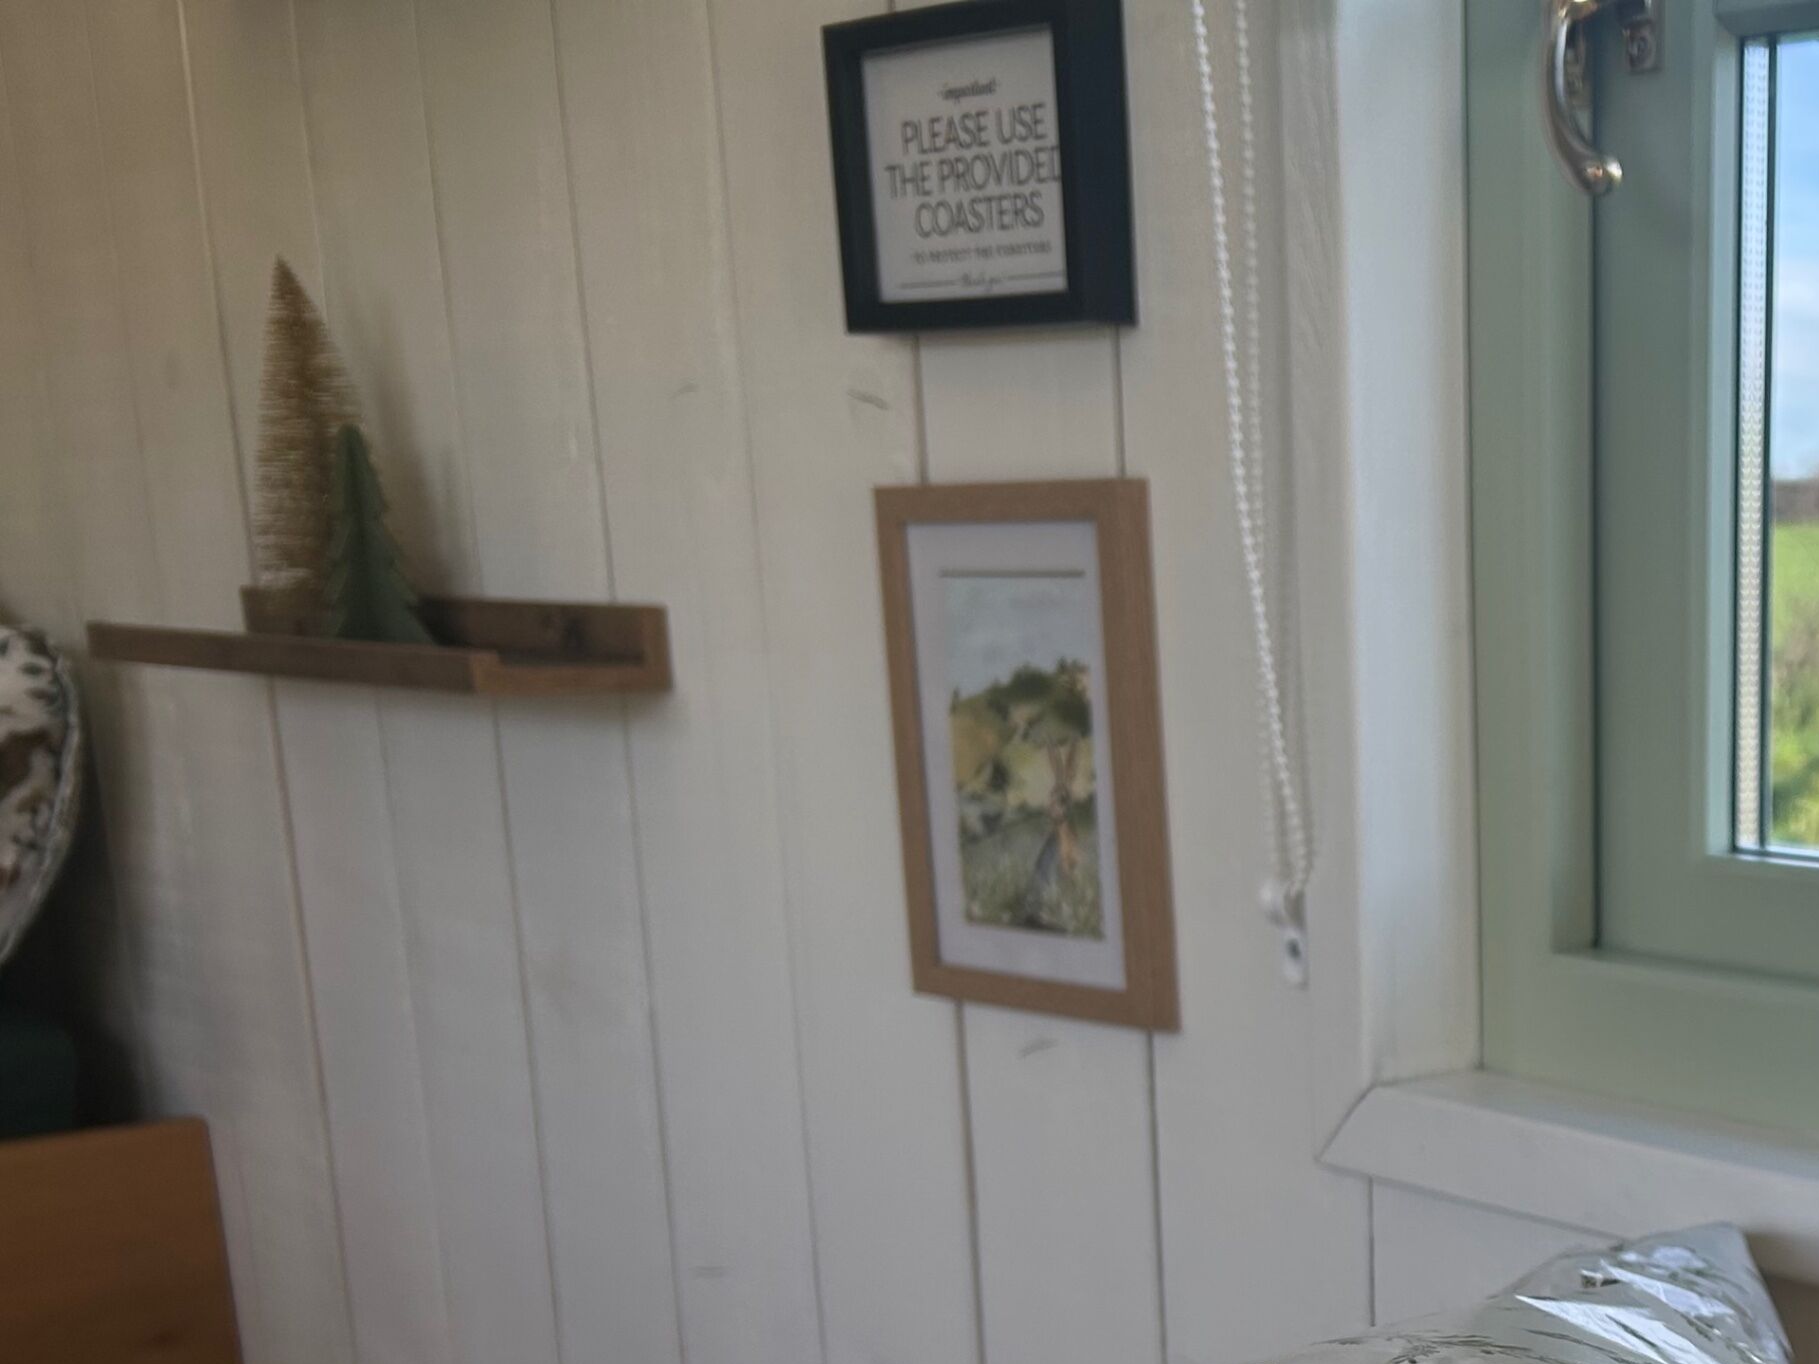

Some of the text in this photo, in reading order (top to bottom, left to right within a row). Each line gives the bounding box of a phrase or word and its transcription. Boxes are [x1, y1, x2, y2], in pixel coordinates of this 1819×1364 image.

[901, 103, 1048, 154] PLEASE USE
[885, 160, 932, 198] THE
[915, 190, 1045, 238] COASTERS
